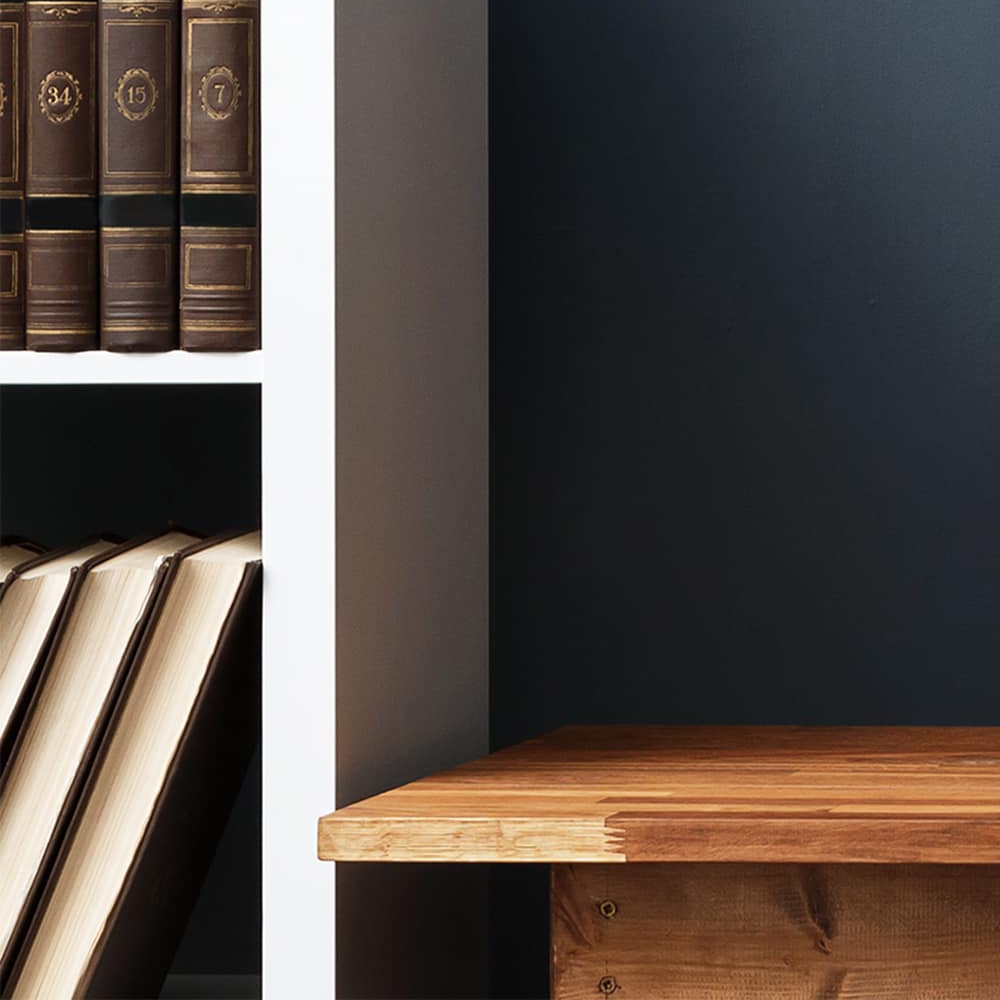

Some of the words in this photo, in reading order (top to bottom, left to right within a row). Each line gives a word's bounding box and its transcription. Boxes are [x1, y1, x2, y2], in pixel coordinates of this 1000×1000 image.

[47, 86, 73, 105] 34
[126, 86, 147, 104] 15
[213, 83, 226, 104] 7
